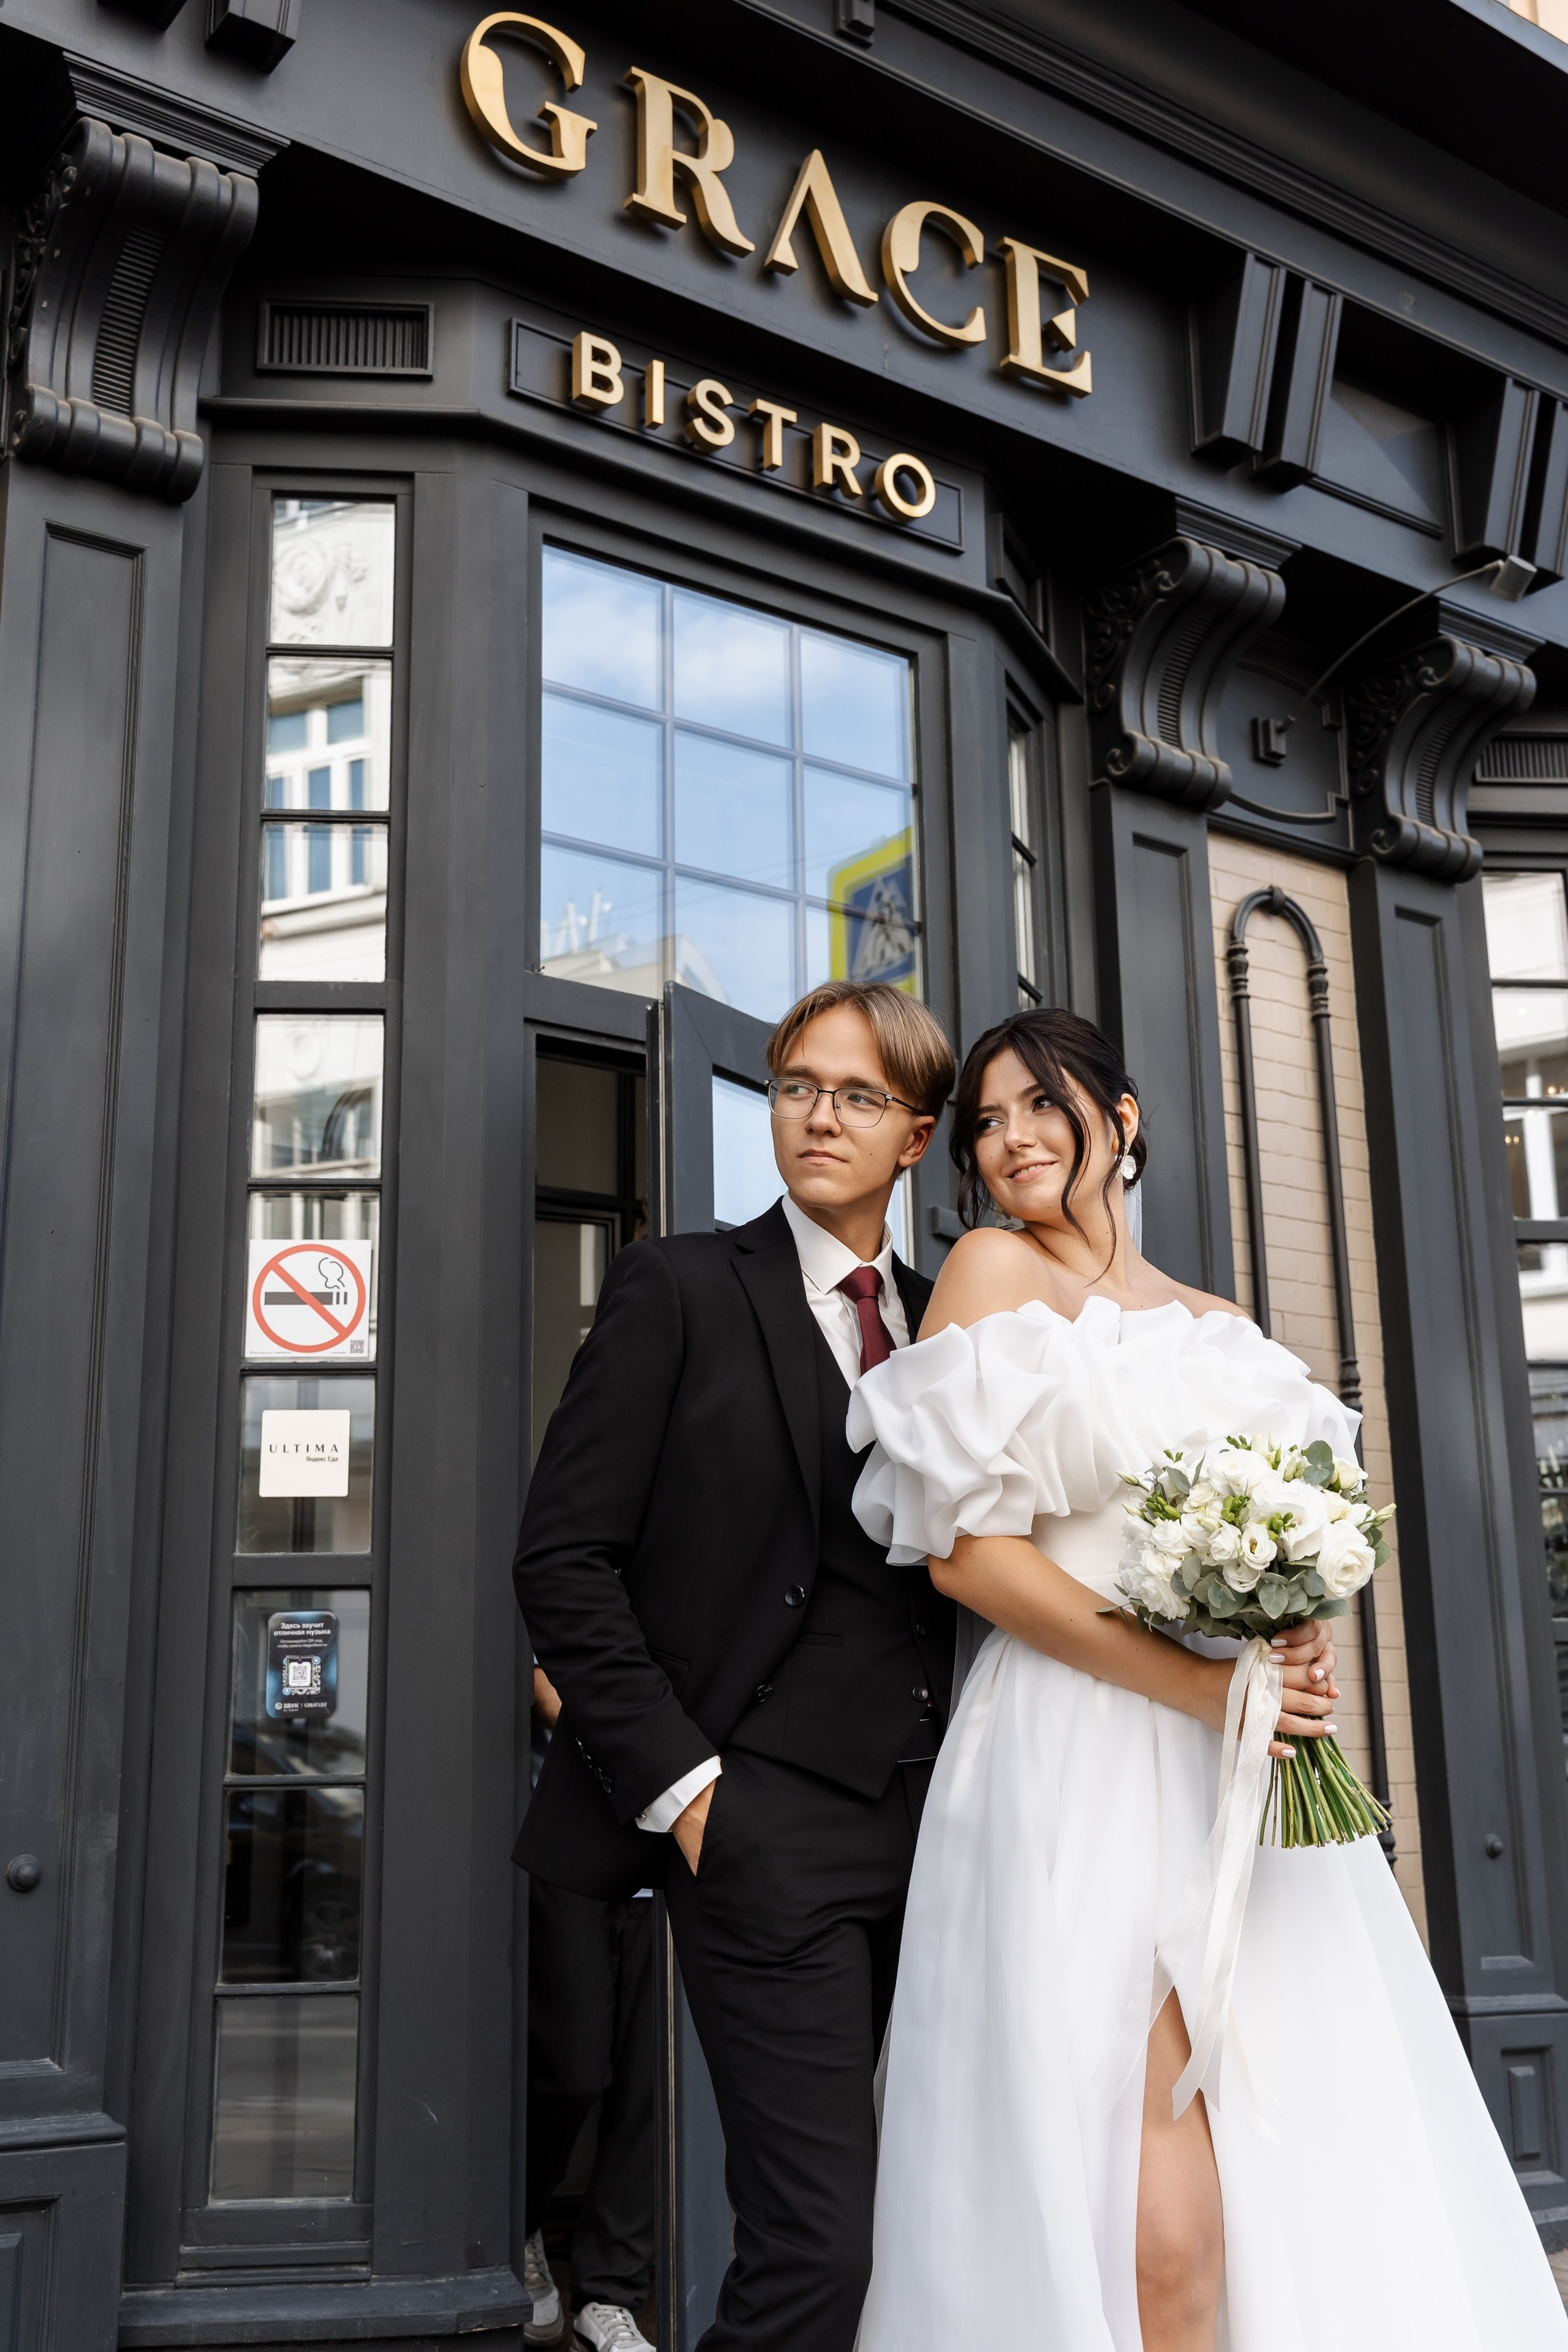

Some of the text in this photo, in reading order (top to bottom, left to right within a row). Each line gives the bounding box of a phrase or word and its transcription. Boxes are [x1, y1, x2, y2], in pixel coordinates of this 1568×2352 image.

[461, 11, 1093, 399] GRACE
[571, 331, 936, 523] BISTRO
[270, 1444, 339, 1453] ULTIMA
